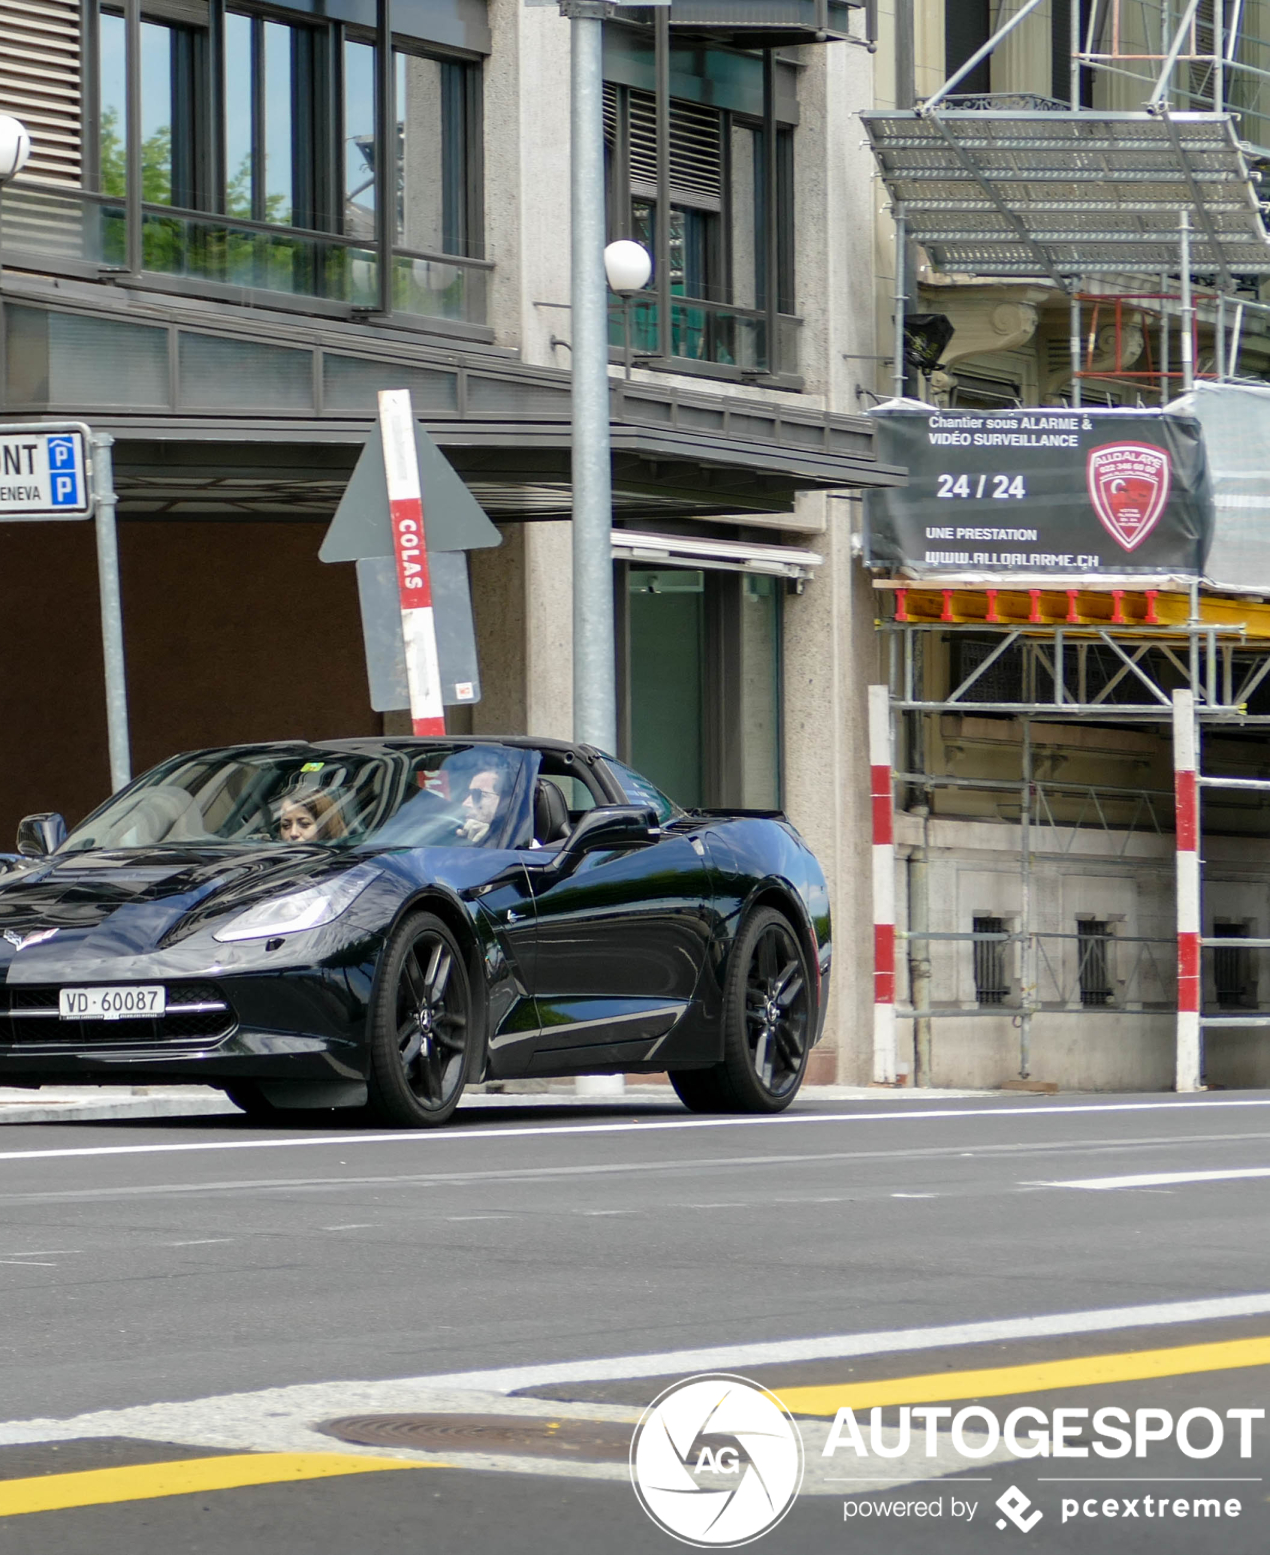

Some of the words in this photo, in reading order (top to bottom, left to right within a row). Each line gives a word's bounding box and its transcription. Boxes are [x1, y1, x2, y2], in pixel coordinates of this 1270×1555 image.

[928, 416, 984, 429] Chantier
[986, 418, 1019, 430] sous
[1020, 417, 1080, 430] ALARME
[1081, 418, 1093, 431] &
[928, 431, 972, 446] VIDÉO
[973, 432, 1079, 447] SURVEILLANCE
[936, 474, 971, 498] 24
[975, 475, 987, 499] /
[991, 475, 1026, 499] 24
[925, 527, 955, 540] UNE
[956, 527, 1038, 541] PRESTATION
[398, 518, 423, 590] COLAS
[925, 551, 1100, 568] WWW.ALLOALARME.CH
